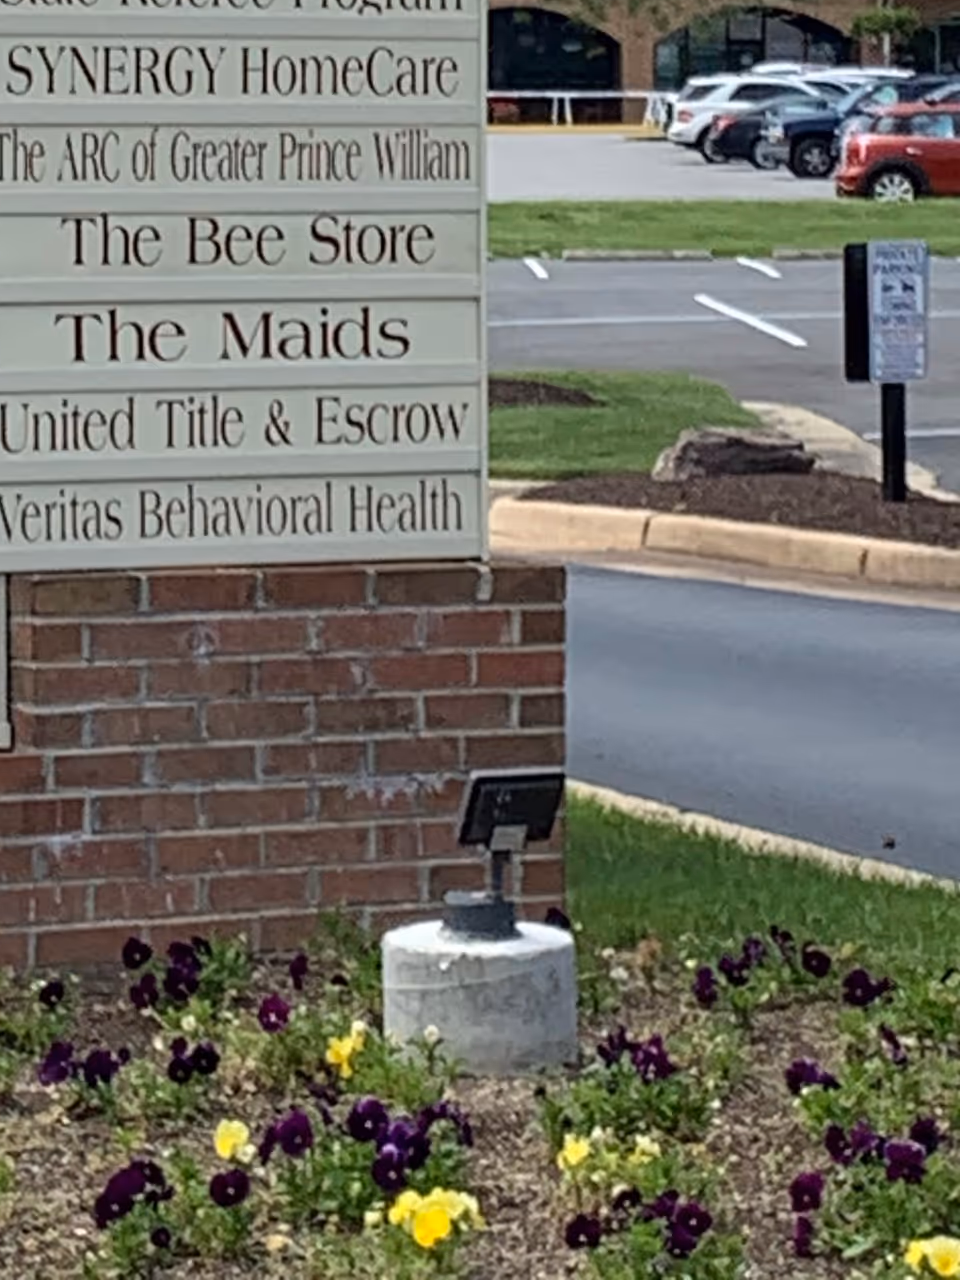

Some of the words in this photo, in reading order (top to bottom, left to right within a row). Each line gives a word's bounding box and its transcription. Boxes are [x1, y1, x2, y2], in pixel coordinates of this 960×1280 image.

[6, 46, 226, 96] SYNERGY
[241, 47, 459, 97] HomeCare
[57, 132, 119, 183] ARC
[132, 129, 158, 182] of
[170, 131, 266, 183] Greater
[278, 130, 361, 182] Prince
[374, 128, 471, 181] William
[60, 214, 163, 267] The
[187, 217, 287, 266] Bee
[309, 213, 436, 265] Store
[54, 308, 188, 362] The
[219, 307, 411, 360] Maids
[0, 397, 136, 454] United
[156, 395, 244, 449] Title
[264, 399, 292, 447] &
[315, 396, 470, 446] Escrow
[140, 481, 333, 539] Behavioral
[349, 478, 463, 534] Health
